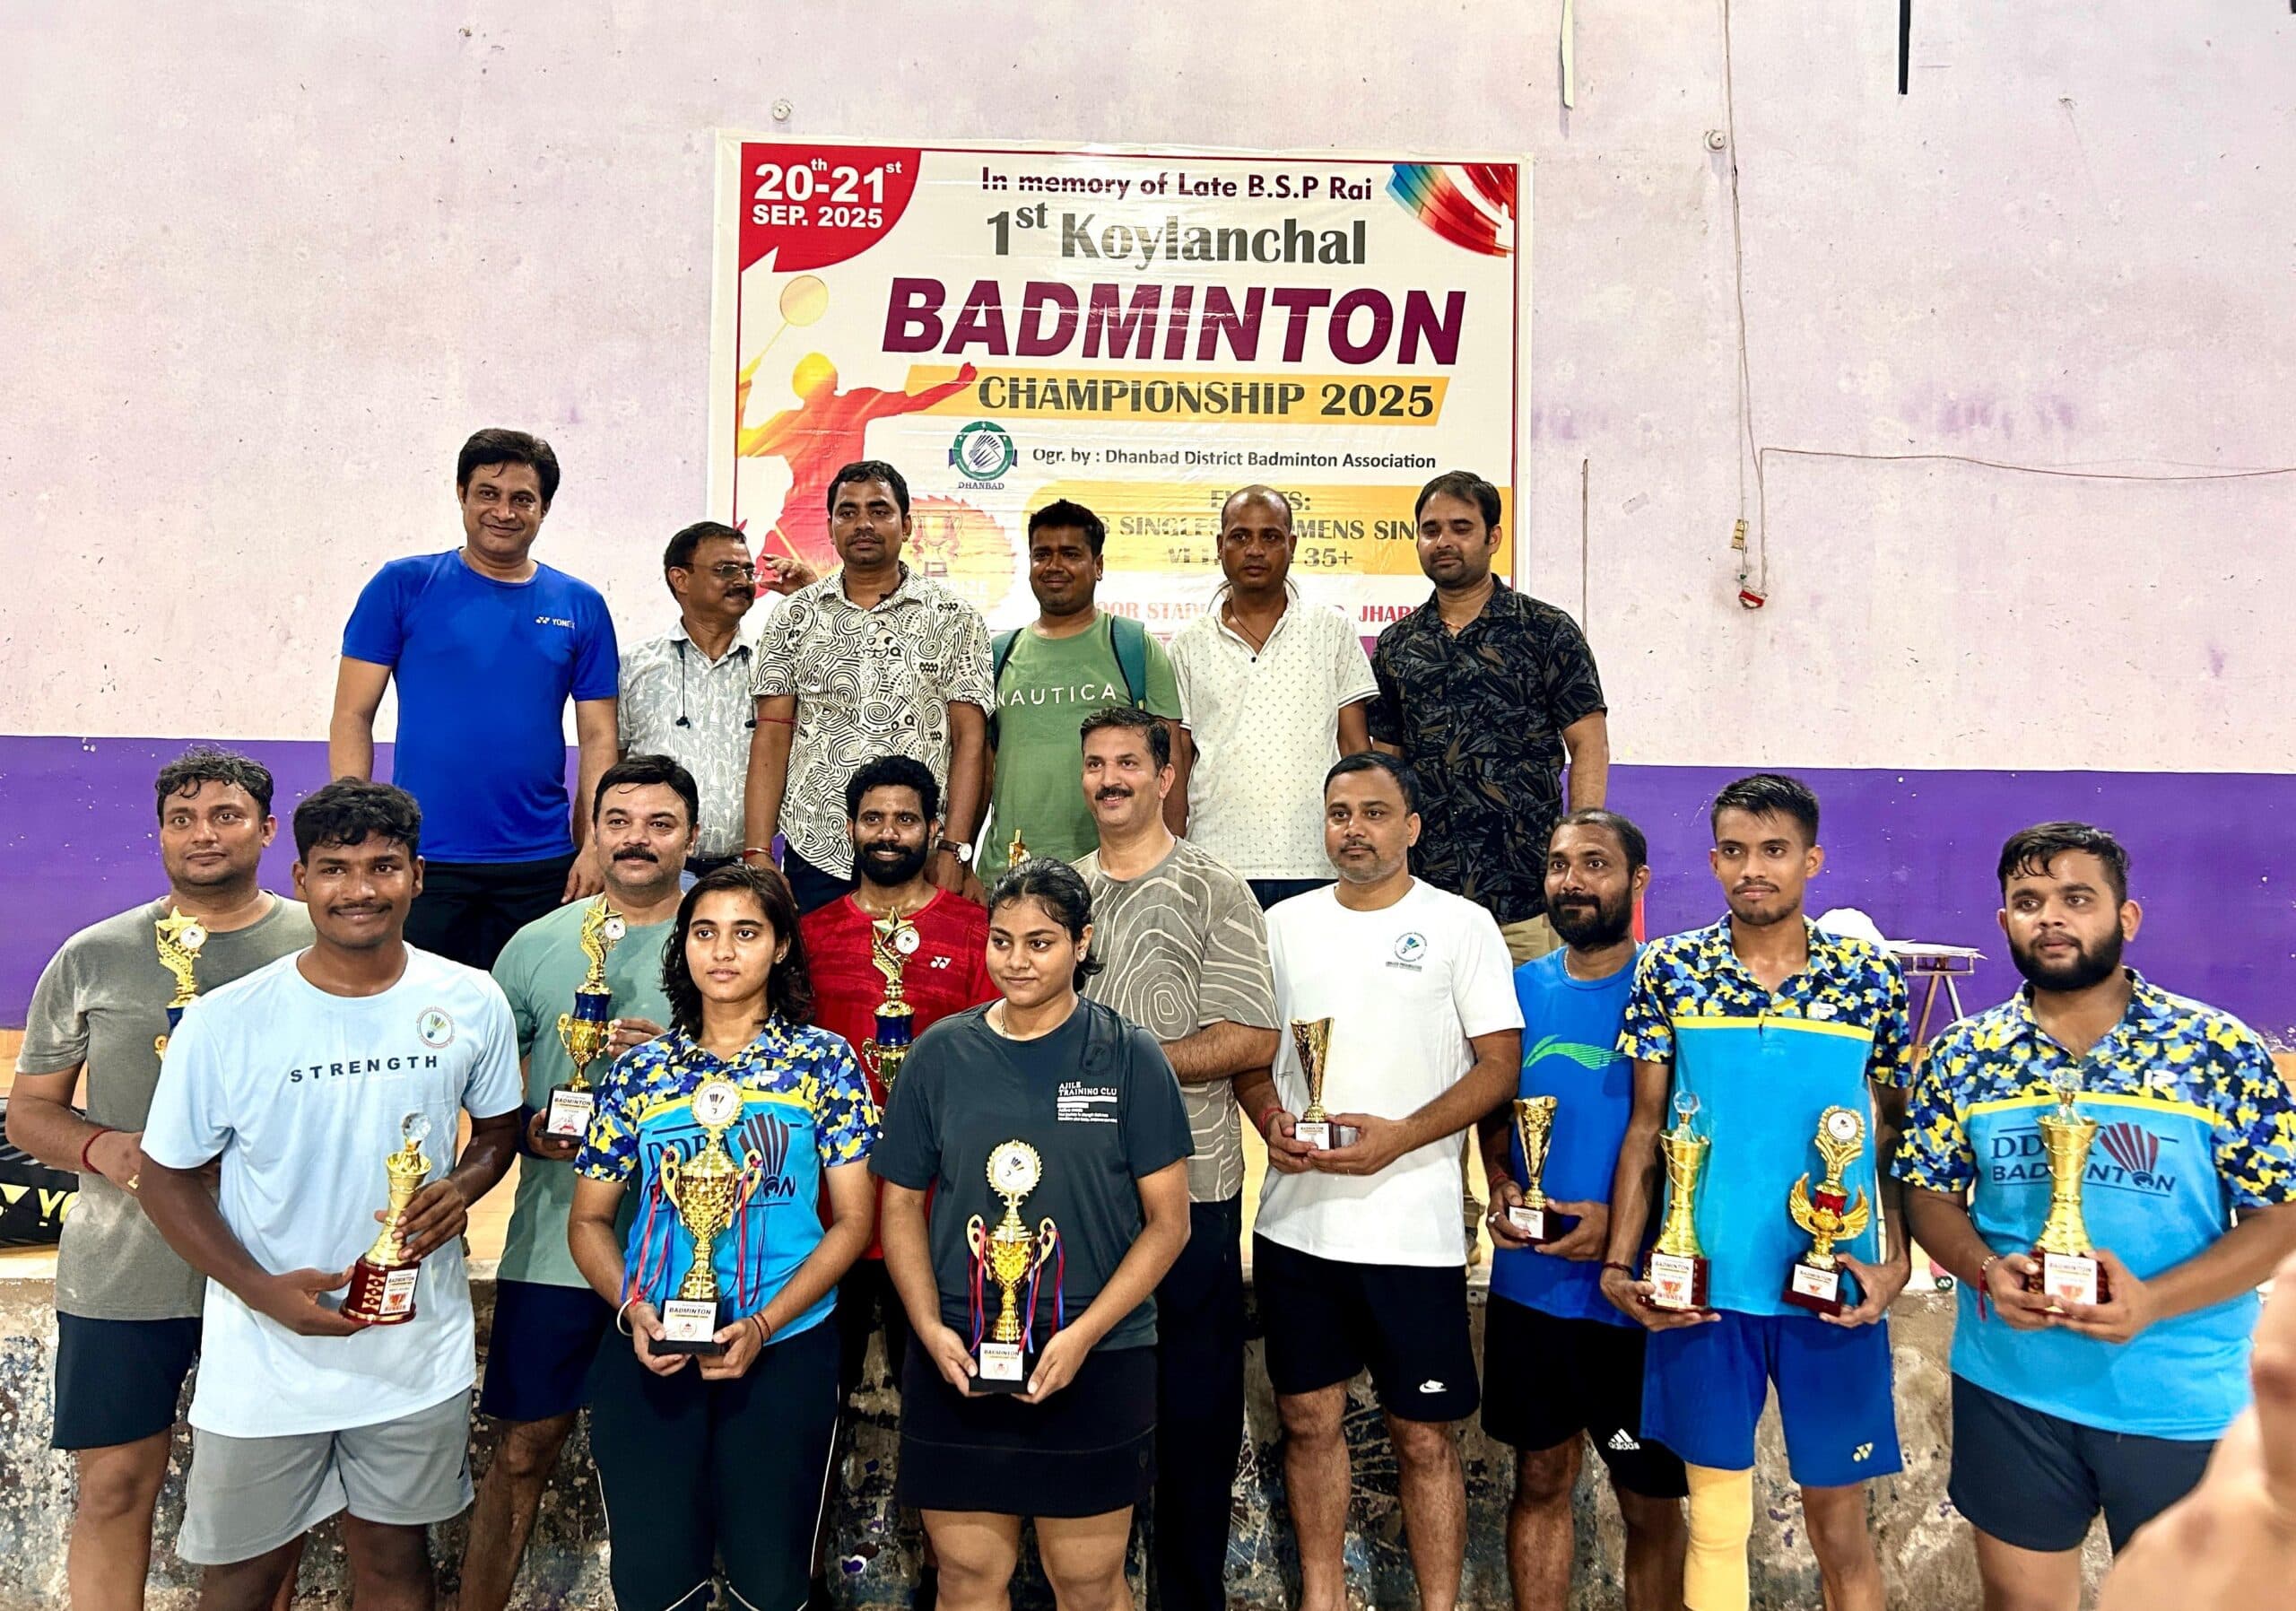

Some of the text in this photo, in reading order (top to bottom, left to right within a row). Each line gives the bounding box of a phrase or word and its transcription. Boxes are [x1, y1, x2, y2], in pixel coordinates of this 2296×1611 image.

[982, 167, 1371, 200] In memory of Late B.S.P Rai
[752, 205, 883, 229] SEP. 2025
[987, 201, 1366, 271] 1st Koylanchal
[882, 276, 1466, 366] BADMINTON
[978, 376, 1433, 418] CHAMPIONSHIP 2025
[1032, 448, 1065, 465] Ogr.
[1071, 448, 1091, 466] by
[1106, 449, 1179, 465] Dhanbad
[1185, 451, 1243, 466] District
[1248, 452, 1338, 466] Badminton
[1343, 454, 1436, 468] Association
[958, 482, 1004, 490] DHANBAD
[1304, 548, 1353, 567] 35+
[995, 684, 1117, 709] NAUTICA
[291, 1056, 438, 1083] STRENGTH
